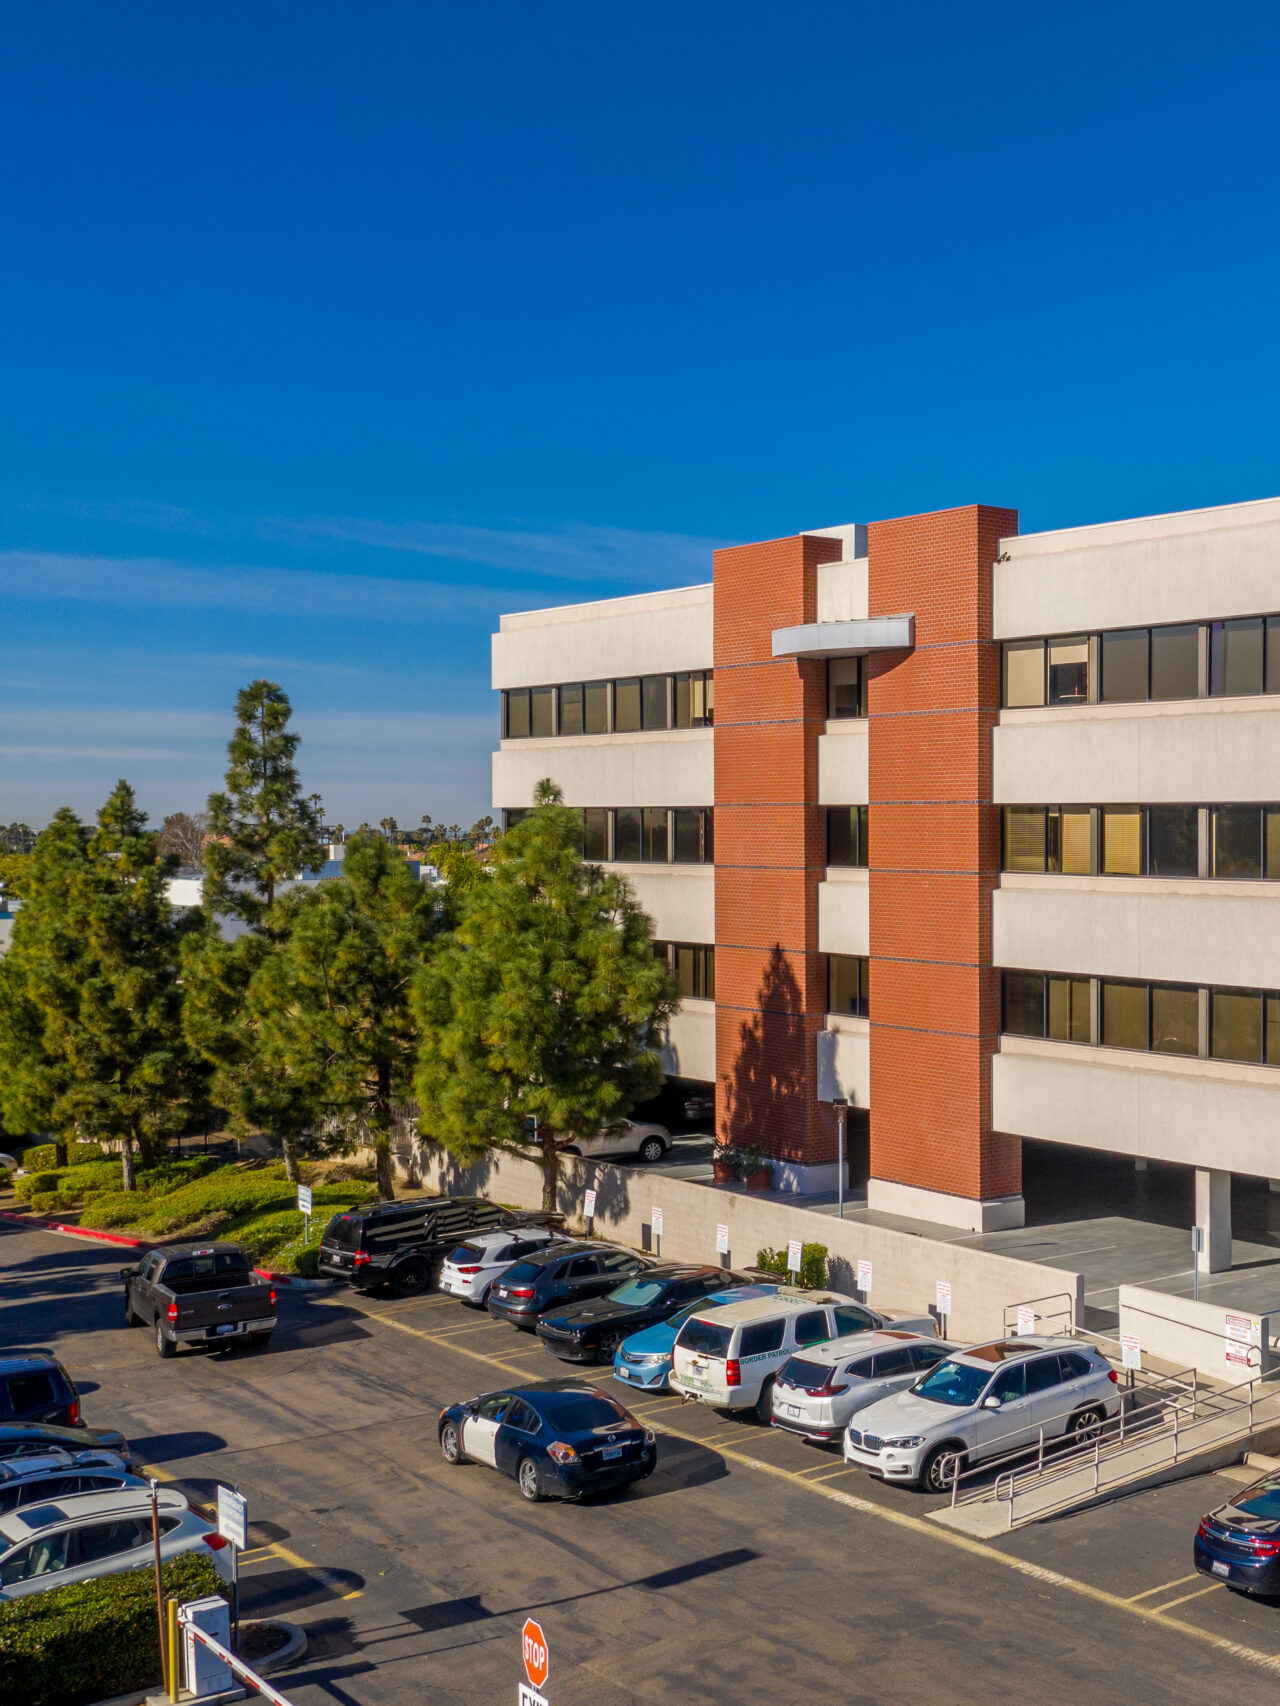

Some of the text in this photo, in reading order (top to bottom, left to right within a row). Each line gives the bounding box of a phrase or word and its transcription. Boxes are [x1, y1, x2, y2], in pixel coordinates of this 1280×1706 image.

[740, 1349, 791, 1365] BORDER PATROL
[1010, 1562, 1072, 1586] PERMIT
[525, 1635, 545, 1671] STOP
